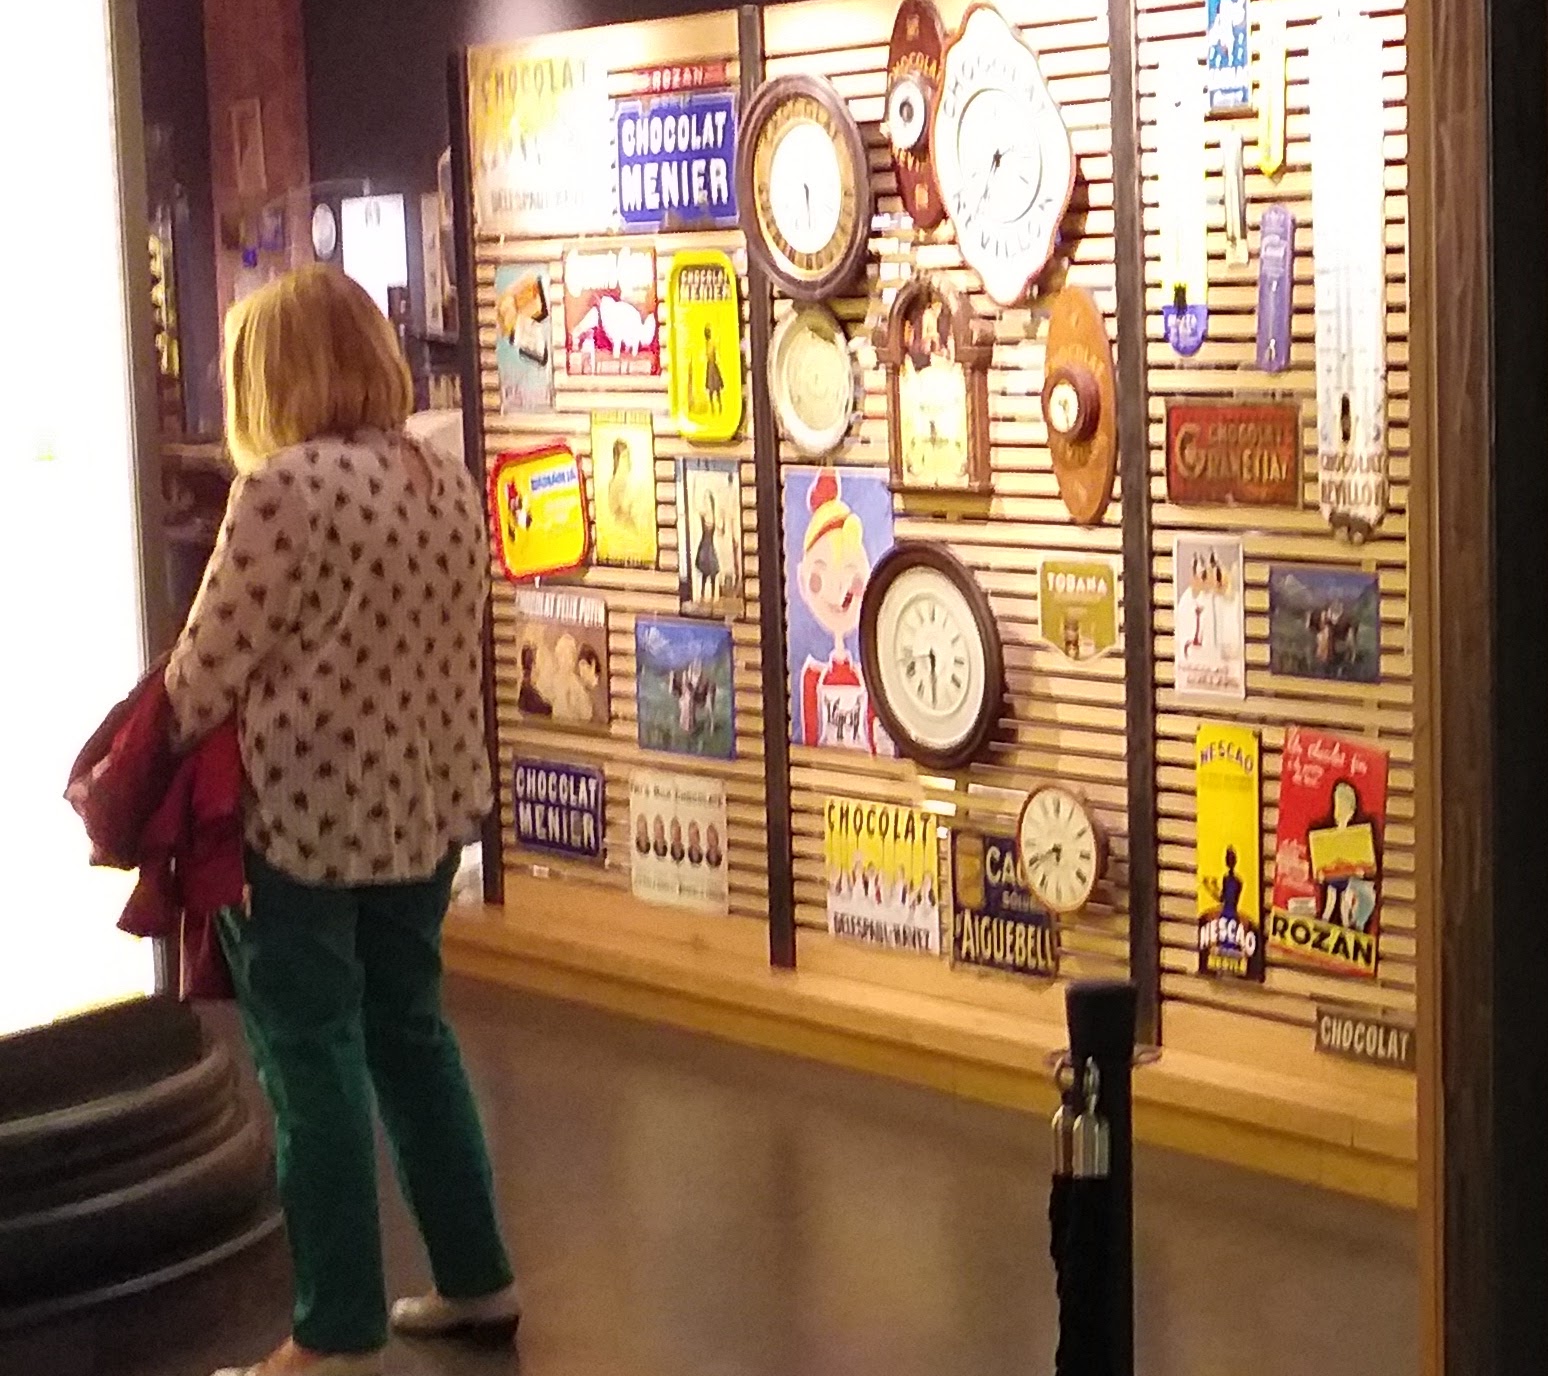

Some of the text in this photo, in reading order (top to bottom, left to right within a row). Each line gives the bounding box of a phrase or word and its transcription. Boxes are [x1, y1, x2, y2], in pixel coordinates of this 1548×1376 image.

[621, 110, 728, 158] CHOCOLAT
[621, 157, 729, 212] MENIER
[515, 765, 598, 811] CHOCOLAT
[827, 799, 931, 847] CHOCOLAT
[1200, 916, 1257, 957] NESCAO
[1271, 915, 1374, 967] ROZAN
[1320, 1015, 1410, 1062] CHOCOLAT
